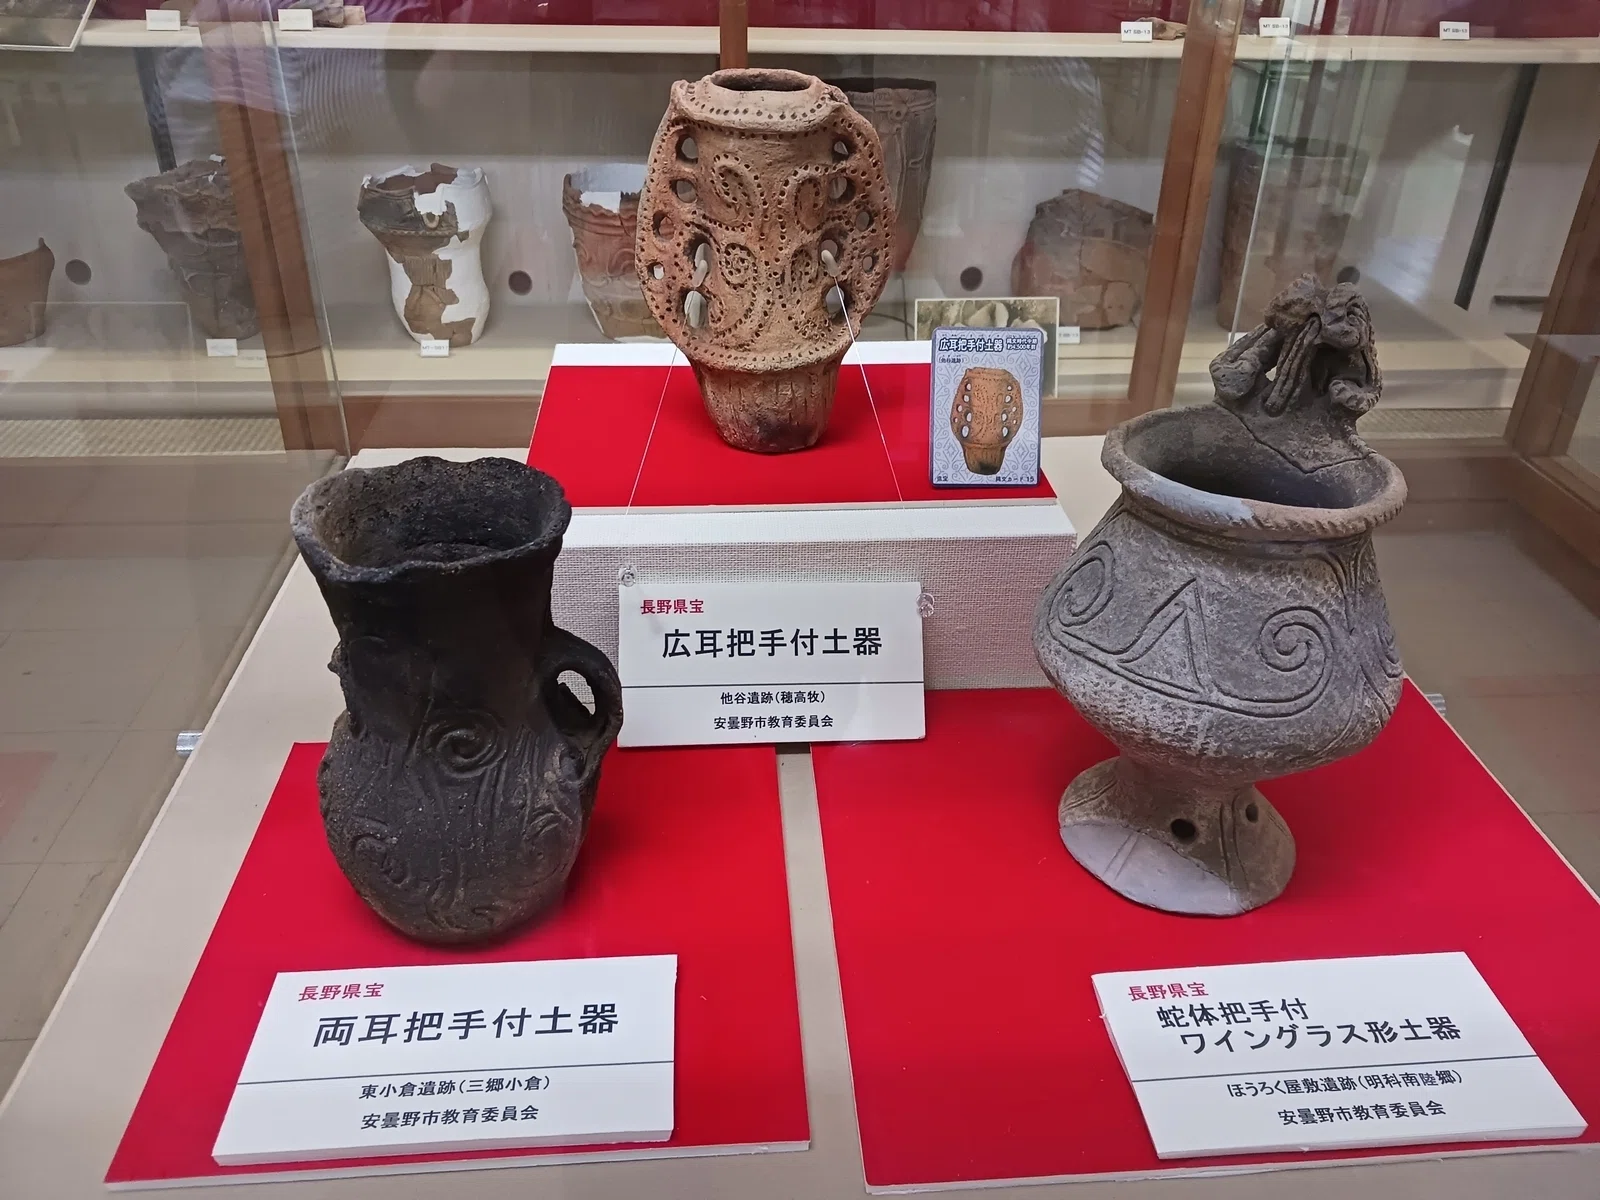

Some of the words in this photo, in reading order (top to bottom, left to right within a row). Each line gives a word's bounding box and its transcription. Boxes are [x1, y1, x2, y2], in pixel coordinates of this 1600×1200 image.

[939, 338, 1003, 352] 広耳把手付土器
[640, 599, 704, 615] 長野県宝
[662, 627, 883, 658] 広耳把手付土器
[720, 690, 826, 706] 他谷遺跡(穂高牧)
[713, 715, 834, 730] 安曇野市教育委員会
[298, 982, 385, 1002] 長野県宝
[1128, 982, 1209, 1001] 長野県宝
[313, 1003, 619, 1047] 両耳把手付土器
[1156, 998, 1309, 1029] 蛇体把手付
[1180, 1016, 1462, 1054] ワイングラス形土器
[358, 1075, 551, 1100] 東小倉遺跡(三郷小倉)
[1227, 1069, 1463, 1098] ほうろく屋敷遺跡(明科南陸郷)
[360, 1105, 540, 1130] 安曇野市教育委員会
[1278, 1100, 1447, 1126] 安曇野市教育委員会
